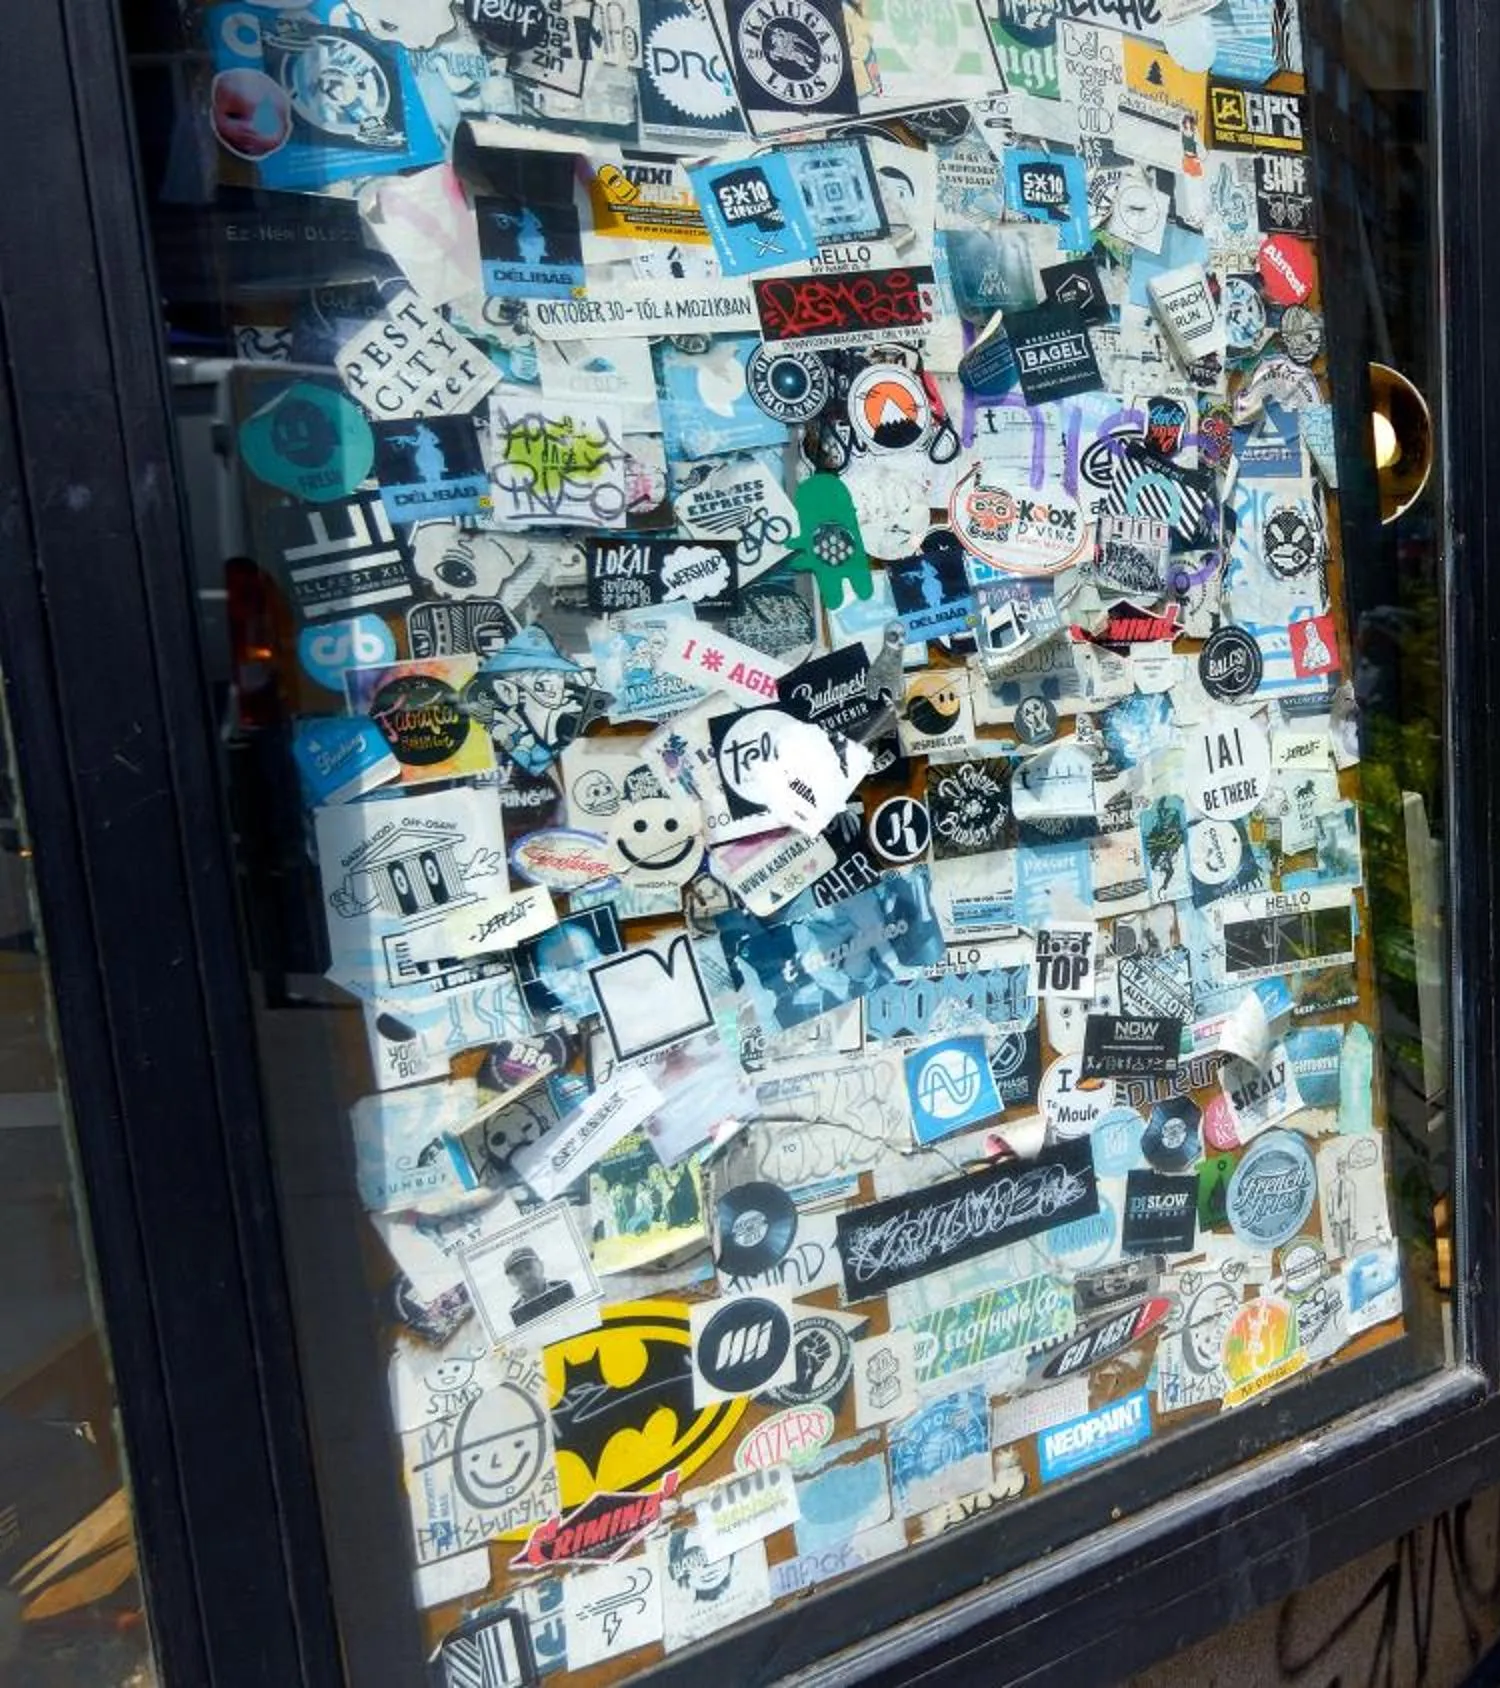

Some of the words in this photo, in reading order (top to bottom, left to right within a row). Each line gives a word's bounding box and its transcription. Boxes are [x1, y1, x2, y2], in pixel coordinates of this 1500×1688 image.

[765, 74, 829, 101] LADS
[1245, 90, 1304, 138] GPS
[1262, 153, 1305, 176] THIS
[1262, 173, 1307, 195] SHIT
[676, 296, 752, 319] MOZIKBAN
[345, 302, 428, 390] PEST
[1024, 342, 1083, 367] BAGEL
[374, 329, 458, 413] CITY
[1203, 788, 1220, 811] BE
[1221, 777, 1259, 806] THERE
[1265, 891, 1311, 909] HELLO
[1036, 955, 1089, 991] TOP
[1114, 1020, 1161, 1038] NOW
[1056, 1068, 1074, 1094] I
[1146, 1192, 1190, 1210] SLOW
[1044, 1400, 1143, 1461] NEOPAINT
